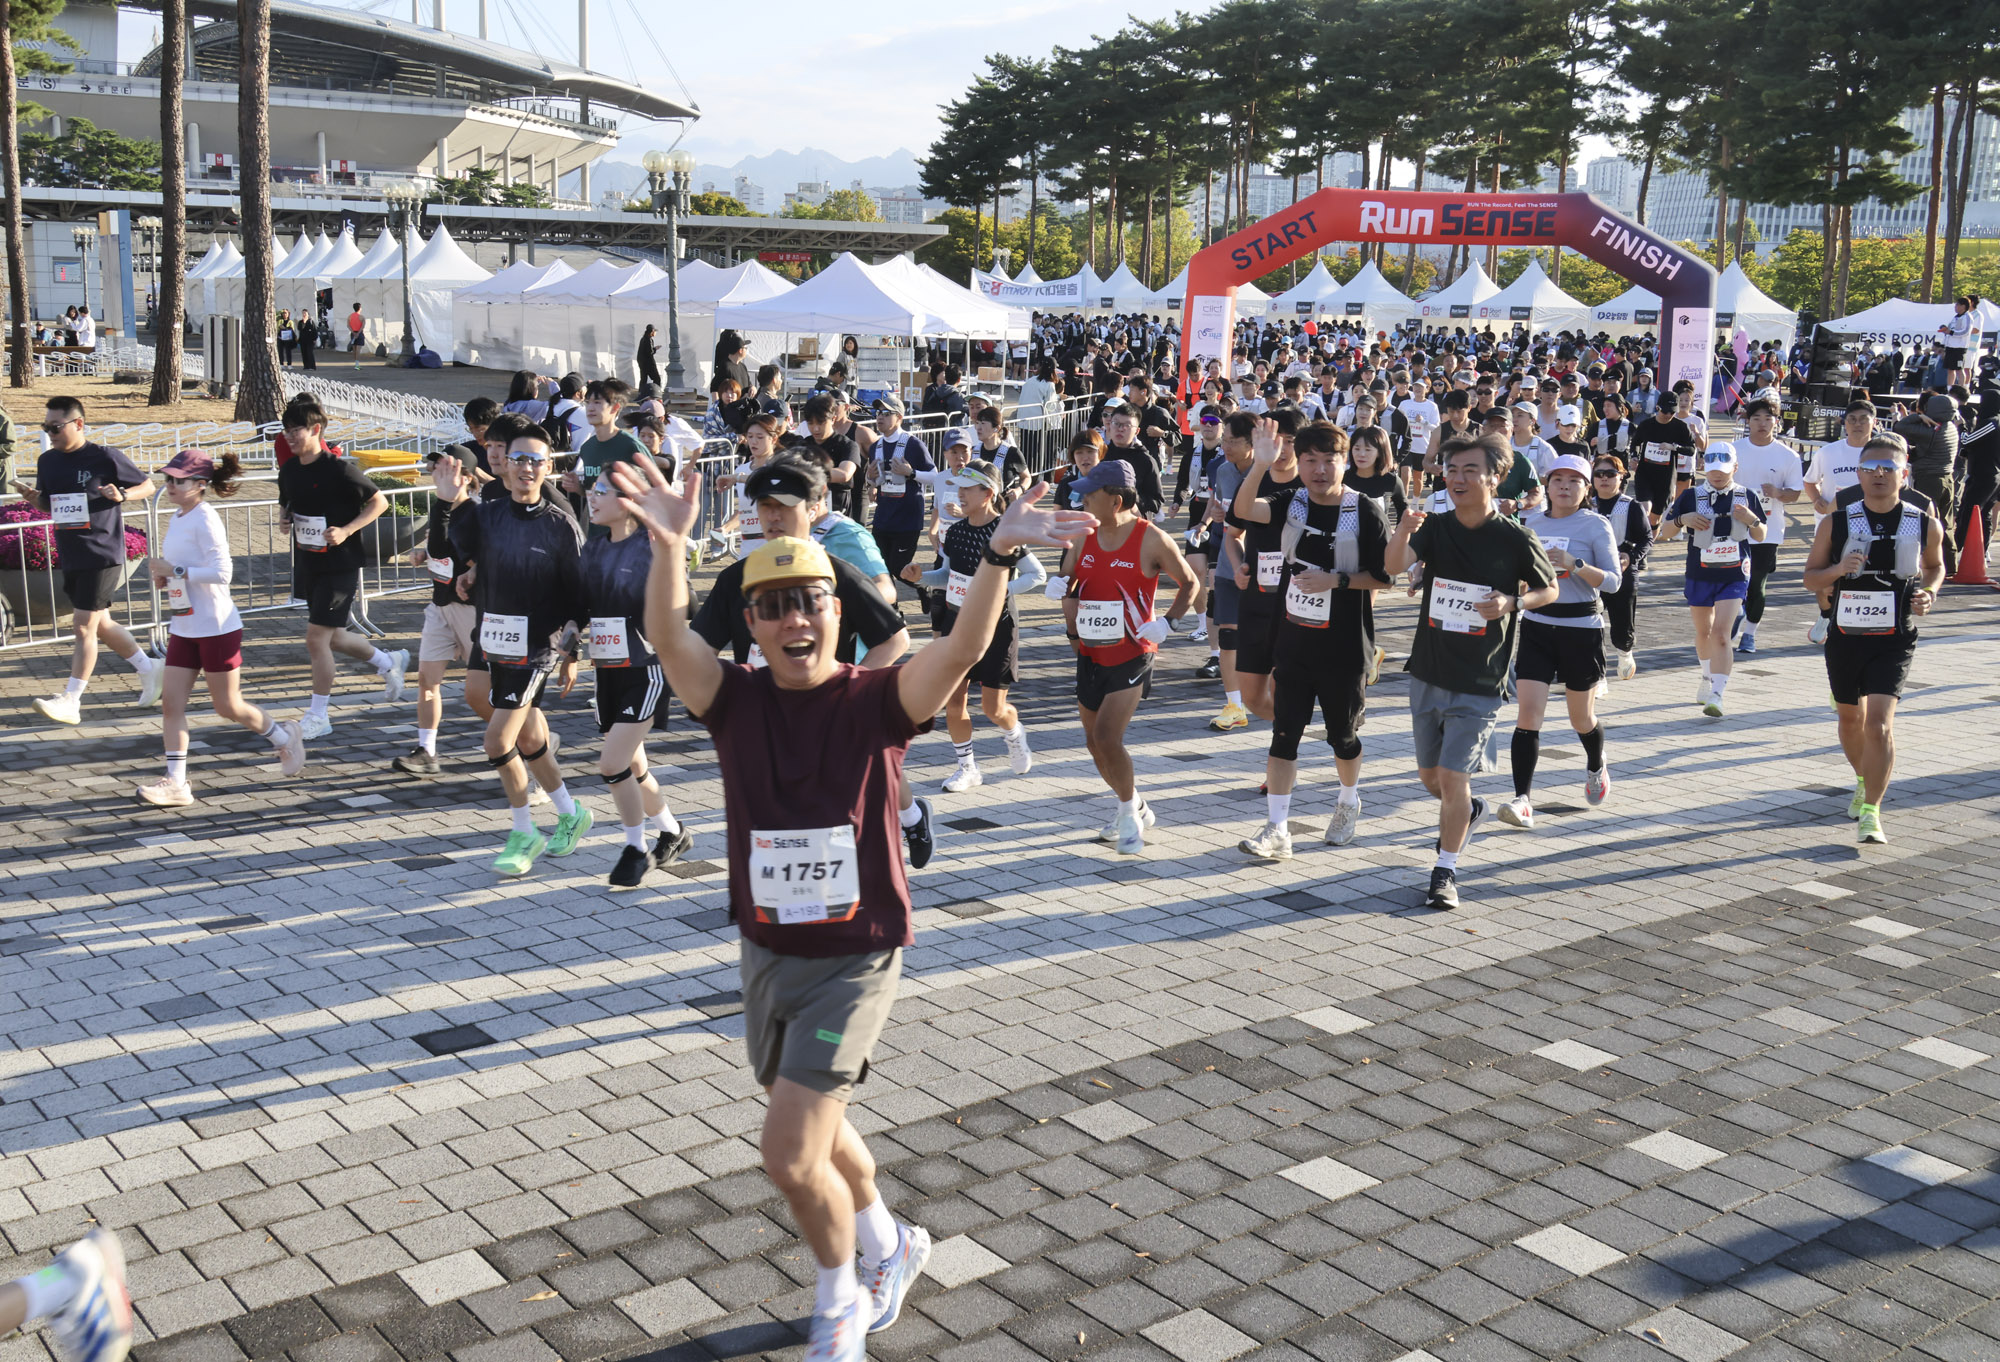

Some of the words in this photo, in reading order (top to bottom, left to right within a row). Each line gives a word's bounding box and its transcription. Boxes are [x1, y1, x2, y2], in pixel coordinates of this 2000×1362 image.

[1359, 201, 1434, 235] Run
[1231, 211, 1317, 270] START
[1590, 216, 1683, 281] FINISH
[1892, 333, 1936, 345] ROOM
[59, 505, 82, 513] 1034
[301, 527, 321, 536] 1031
[1714, 546, 1737, 554] 2225
[1295, 594, 1324, 607] 1742
[1436, 597, 1445, 605] M
[1855, 606, 1887, 615] 1324
[1088, 617, 1117, 627] 1620
[491, 631, 520, 643] 1125
[595, 635, 621, 645] 2076
[761, 866, 775, 879] M
[782, 860, 843, 882] 1757
[785, 904, 821, 918] A-192
